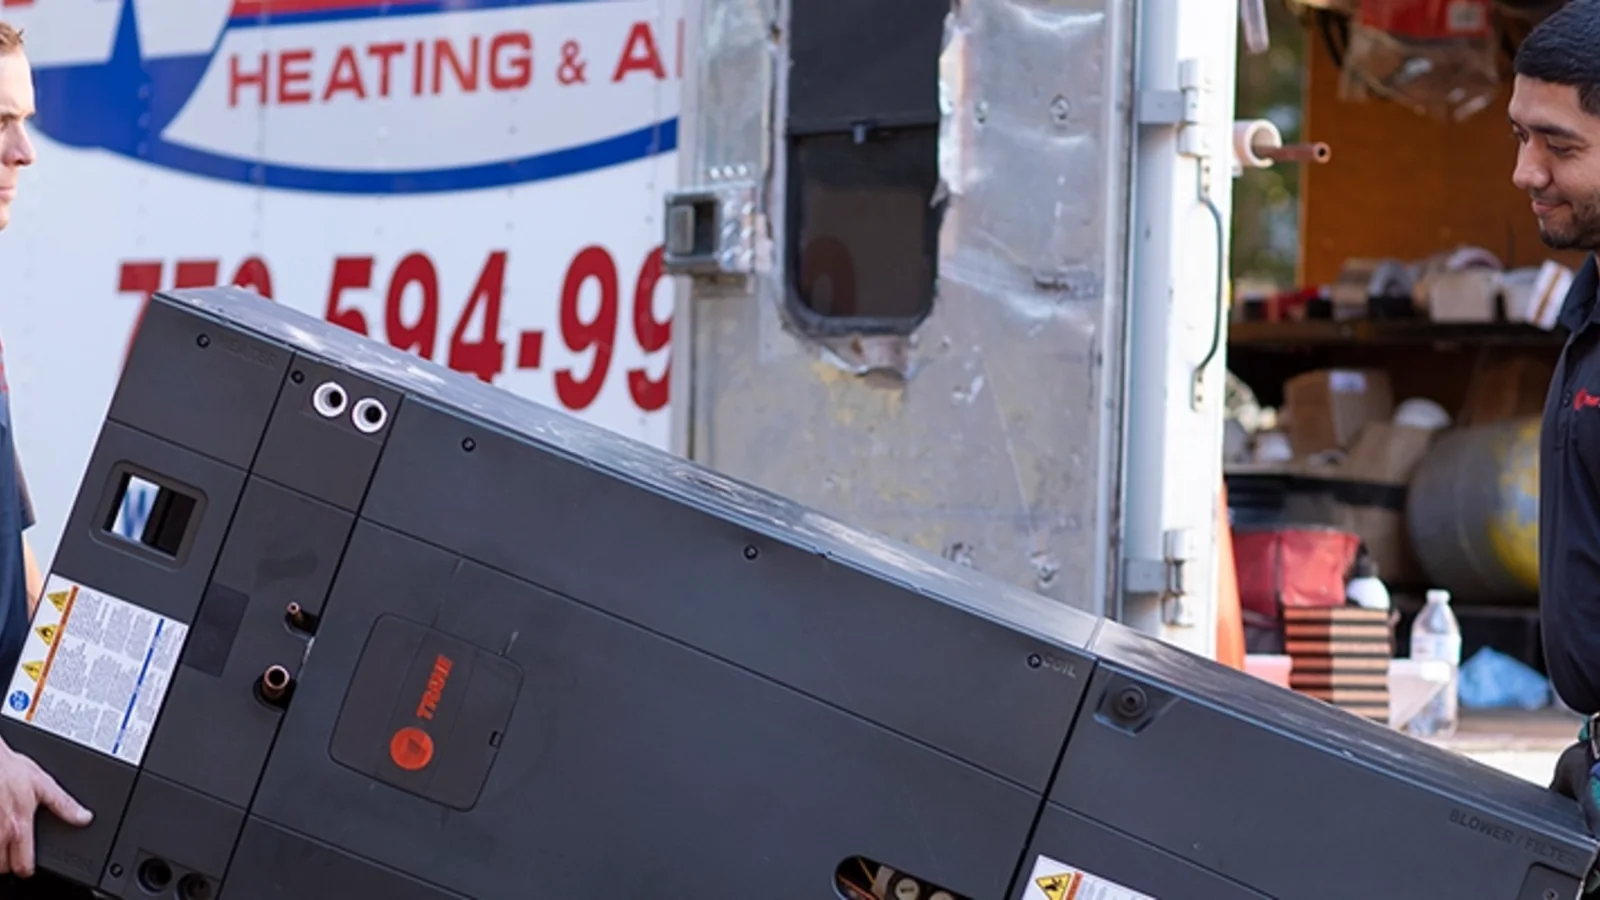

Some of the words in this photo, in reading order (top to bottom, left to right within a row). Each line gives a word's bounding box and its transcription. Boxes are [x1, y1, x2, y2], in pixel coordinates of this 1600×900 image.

[228, 32, 533, 109] HEATING
[556, 40, 587, 86] &
[416, 654, 454, 721] TRANE
[1041, 653, 1077, 679] COIL
[1449, 807, 1515, 845] BLOWER
[1524, 837, 1580, 867] FILTER
